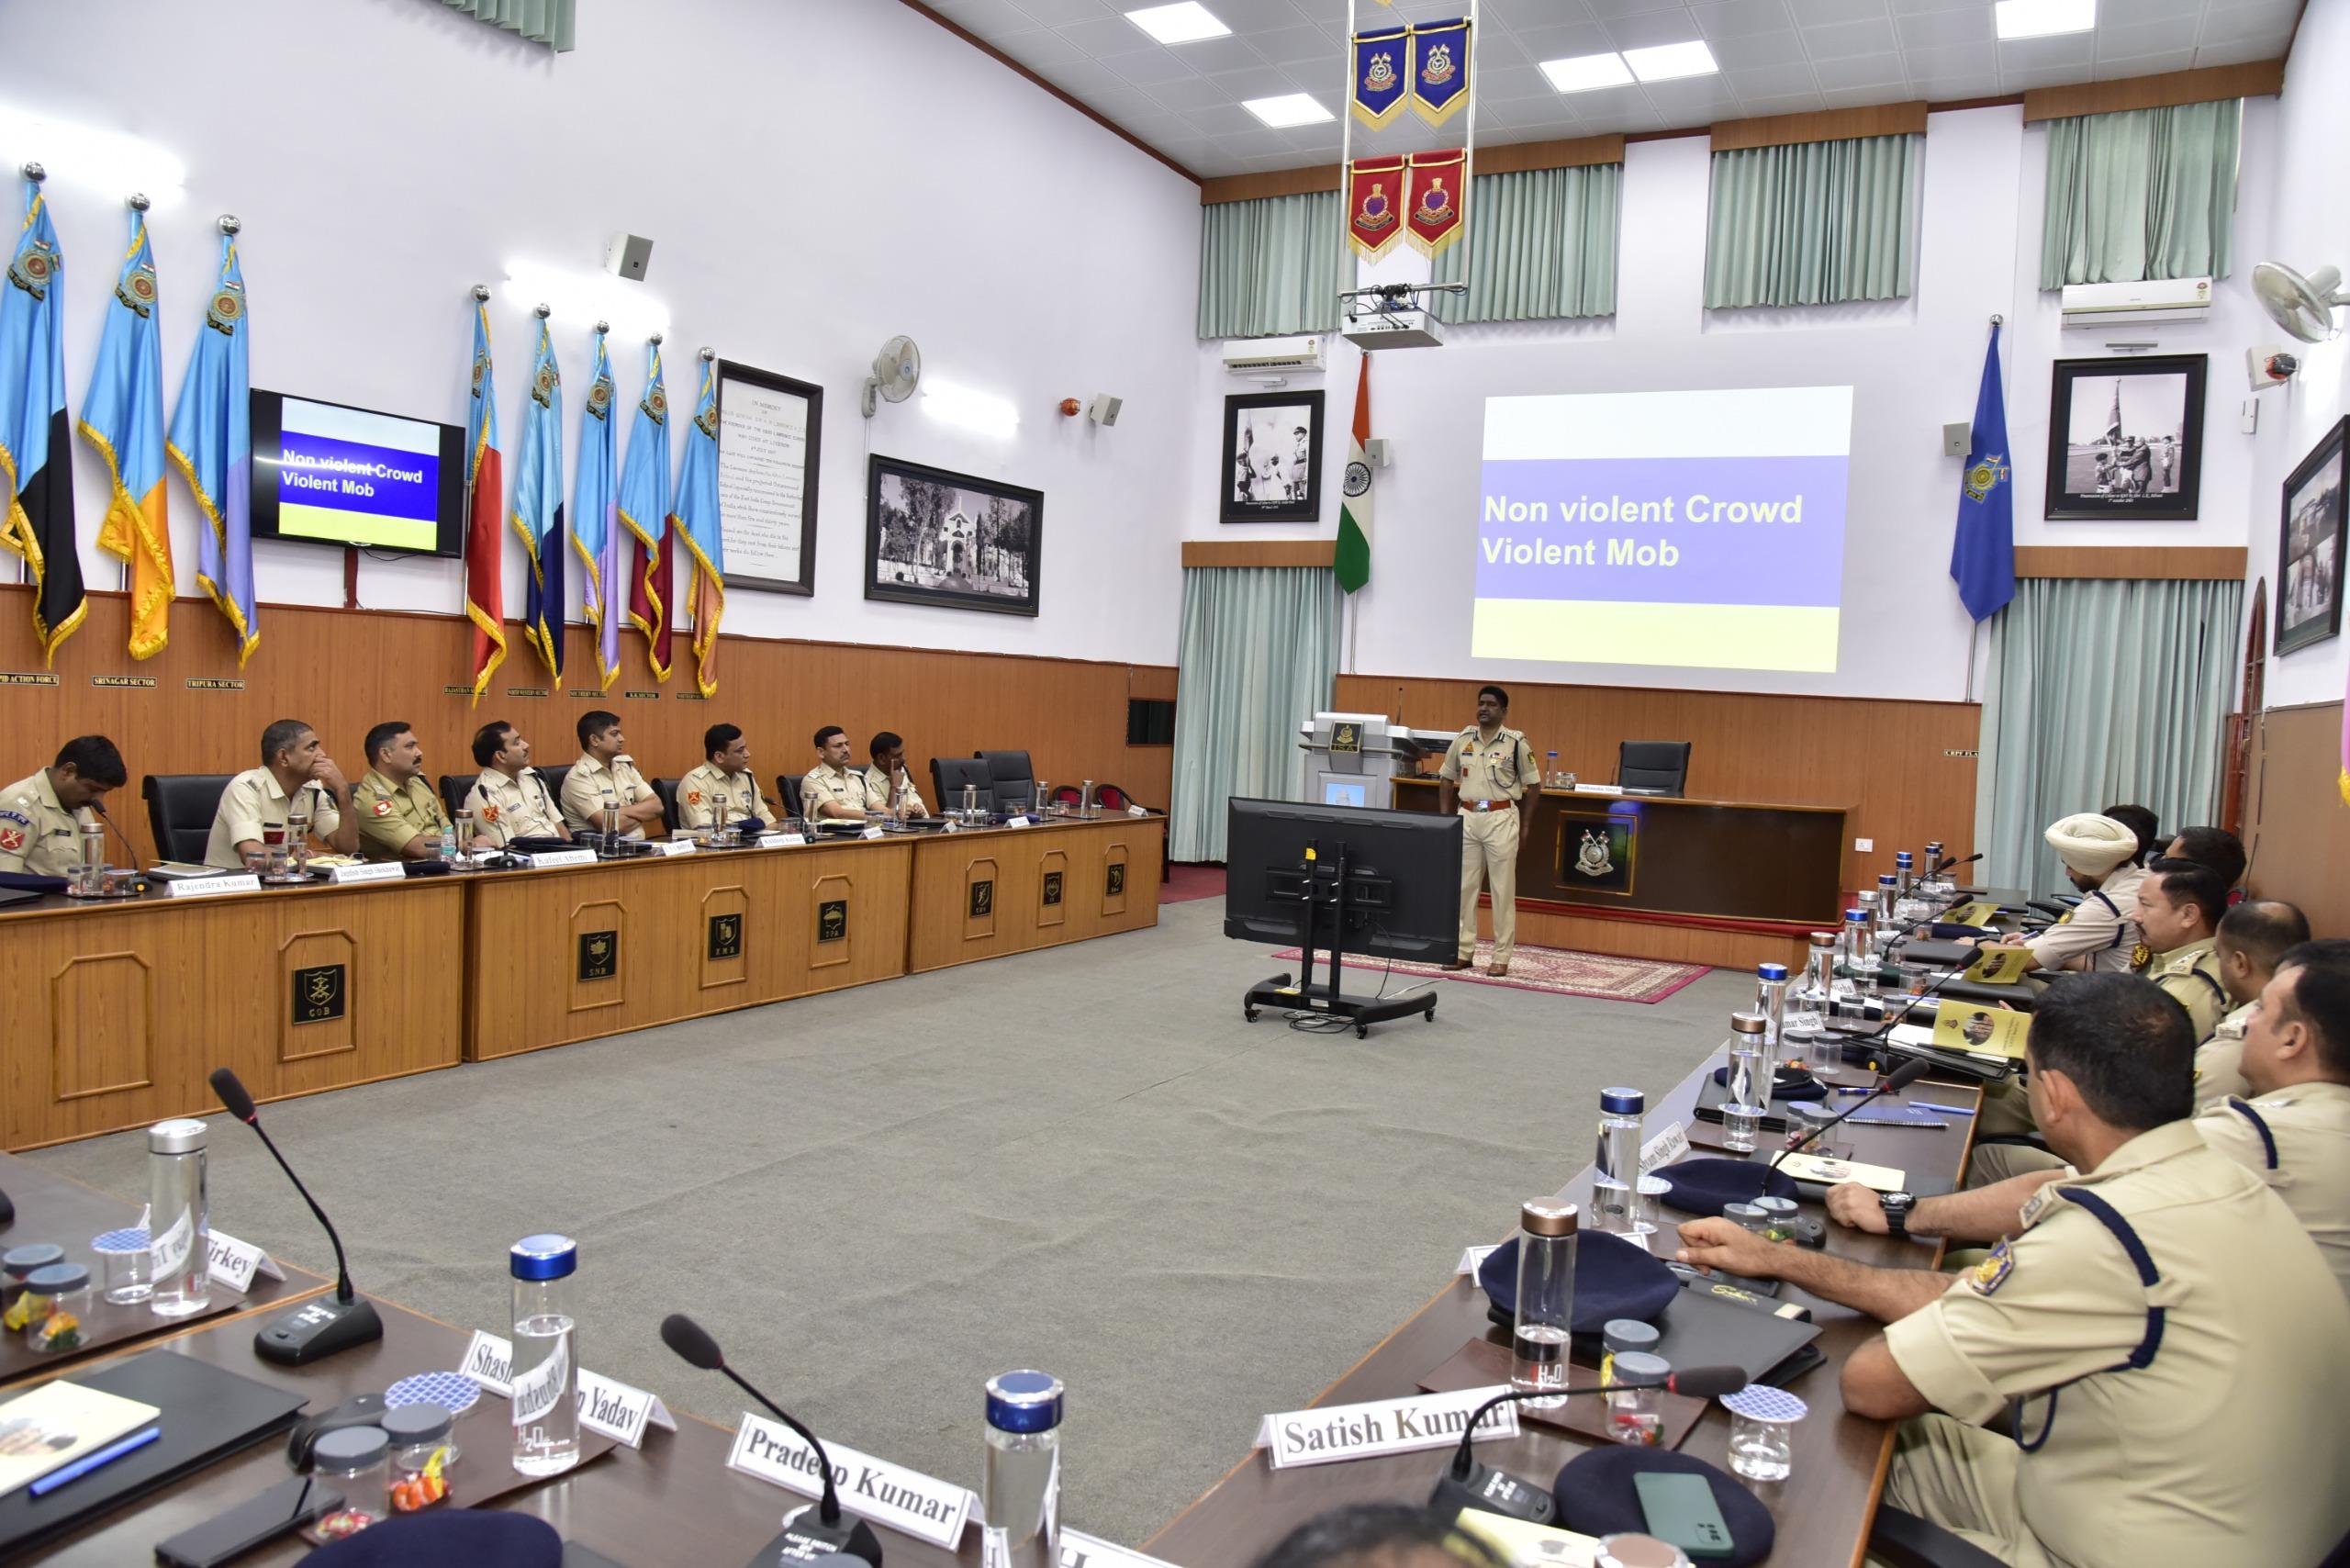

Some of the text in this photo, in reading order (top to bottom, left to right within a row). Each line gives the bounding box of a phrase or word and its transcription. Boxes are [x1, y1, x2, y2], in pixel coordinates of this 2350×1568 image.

[283, 449, 423, 484] Non violent Crowd
[282, 471, 375, 497] Violent Mob
[1484, 494, 1802, 524] Non violent Crowd
[1482, 537, 1679, 567] Violent Mob
[94, 678, 156, 687] SRINAGAR SECTOR
[187, 680, 217, 689] TRIPURA
[177, 878, 255, 893] Rajendra Kumar
[1798, 1015, 1818, 1029] Singh
[208, 1237, 252, 1279] irkey
[471, 1343, 514, 1386] Shash
[589, 1386, 639, 1433] Yadav
[1285, 1414, 1384, 1455] Satish
[747, 1427, 957, 1524] Pradep Kumar
